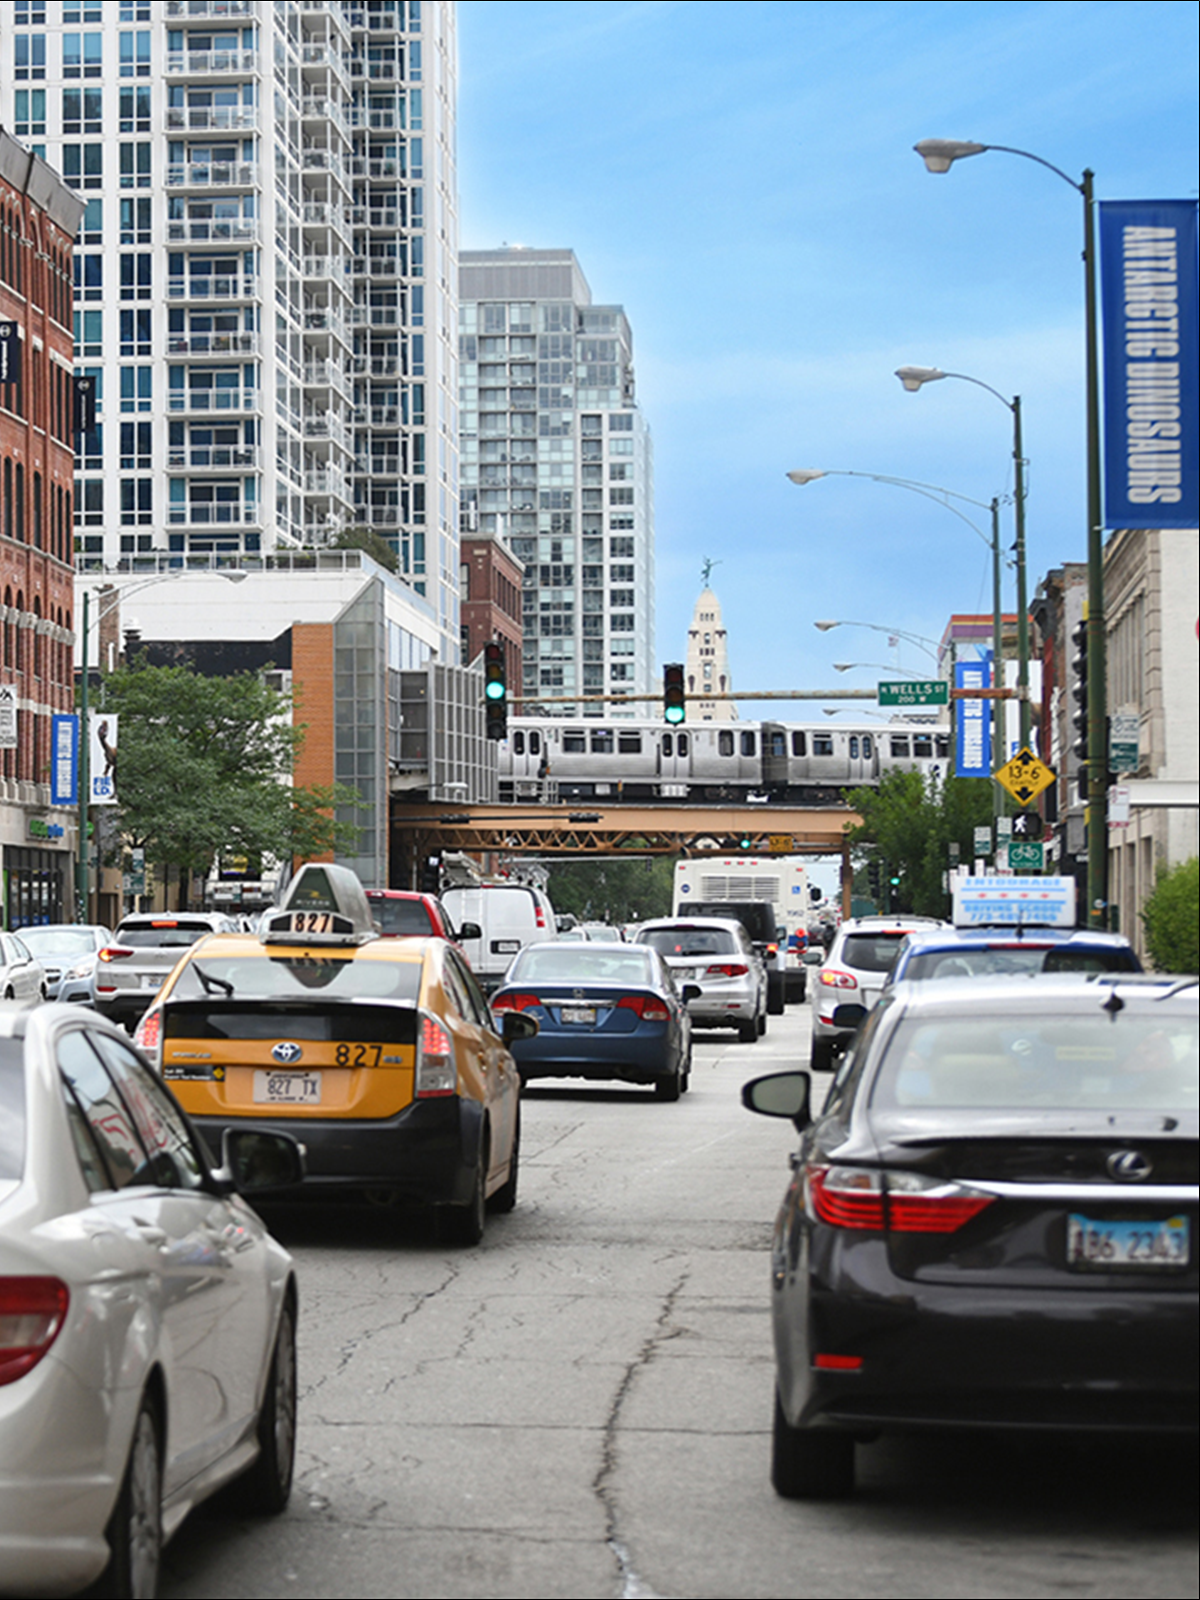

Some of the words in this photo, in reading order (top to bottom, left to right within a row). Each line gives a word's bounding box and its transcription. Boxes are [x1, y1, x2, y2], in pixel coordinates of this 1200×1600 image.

[1123, 226, 1180, 357] ANTARCTIC
[1126, 362, 1181, 504] DINOSAURS
[889, 684, 933, 695] WELLS
[898, 695, 915, 703] 200
[1009, 765, 1041, 780] 13-6
[295, 912, 331, 933] 827
[335, 1044, 383, 1067] 827
[267, 1079, 292, 1095] 827
[302, 1080, 318, 1096] TX
